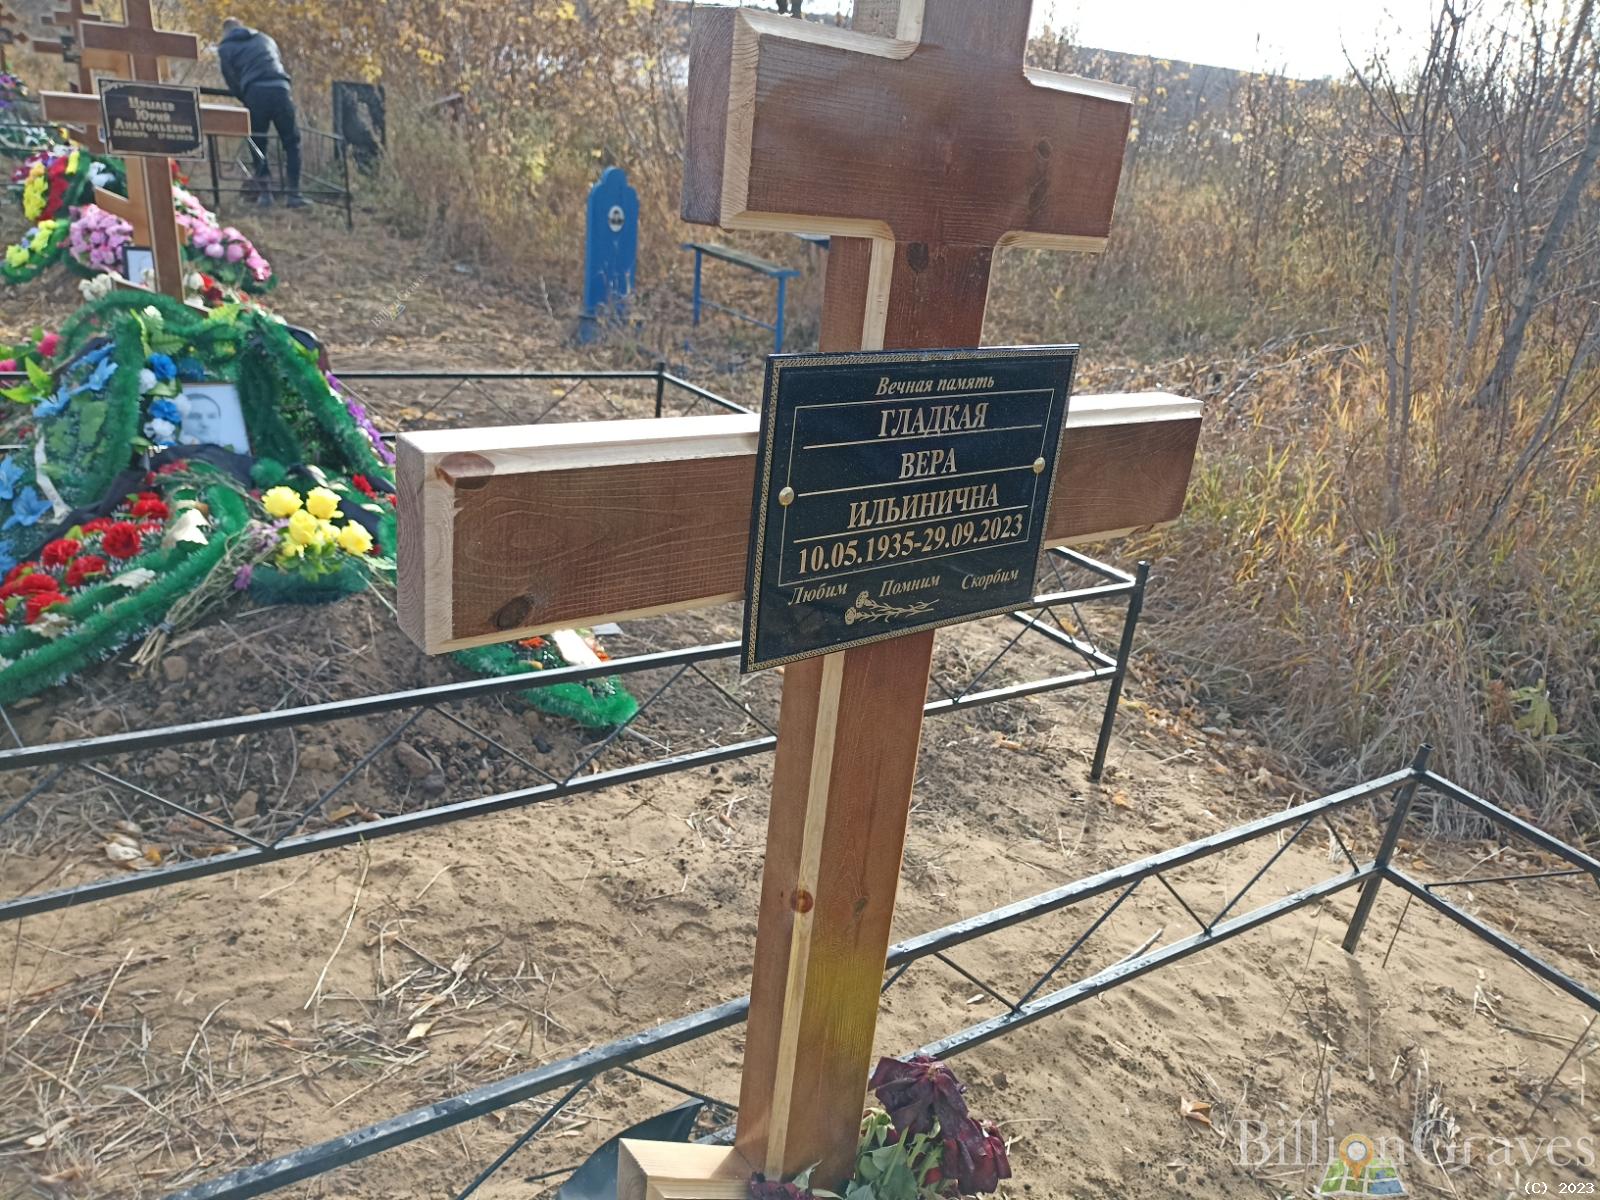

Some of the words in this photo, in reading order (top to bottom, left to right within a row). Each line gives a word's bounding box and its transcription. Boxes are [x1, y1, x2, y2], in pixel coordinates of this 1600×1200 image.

[875, 377, 933, 396] Вечная
[936, 376, 995, 392] память
[878, 402, 989, 438] ГЛАДКАЯ
[899, 447, 957, 480] ВЕРА
[847, 483, 999, 529] ИЛЬИНИЧНА
[798, 514, 1024, 574] 10.05.1935-29.09.2023
[788, 582, 848, 606] Любим
[878, 574, 941, 598] Помним
[961, 567, 1020, 590] Скорбим
